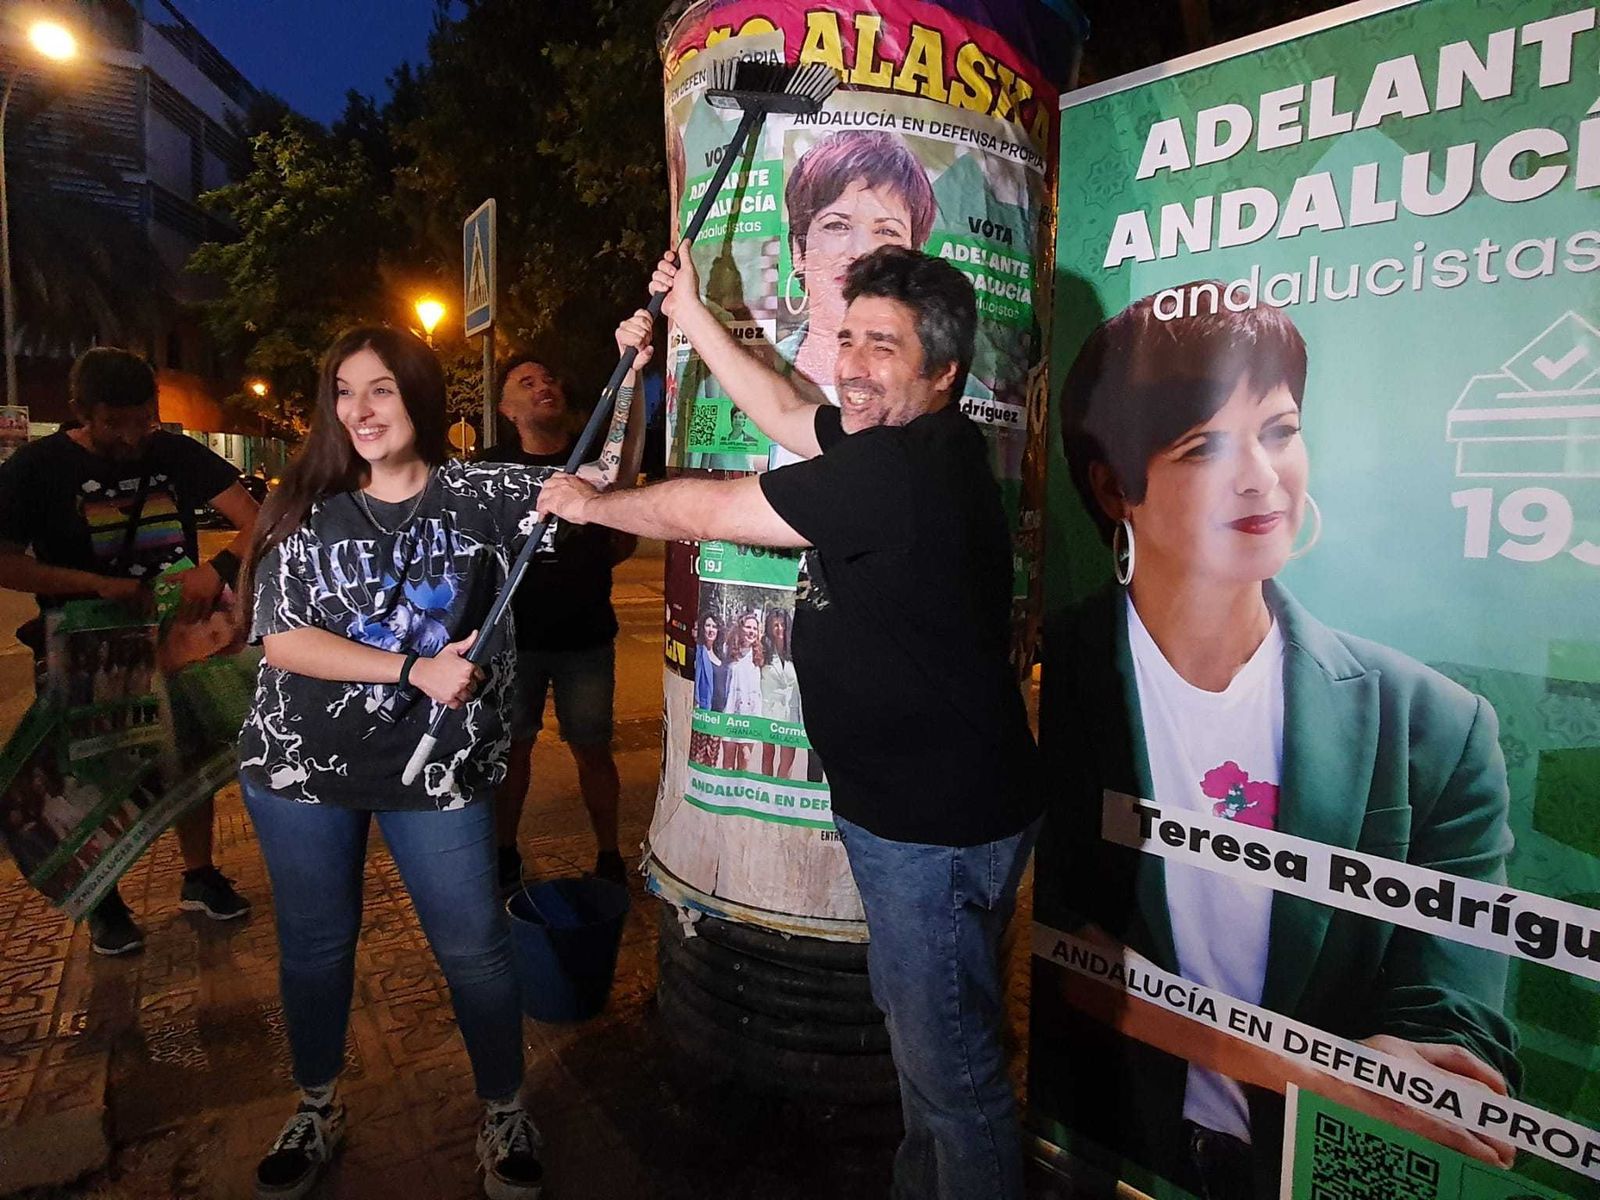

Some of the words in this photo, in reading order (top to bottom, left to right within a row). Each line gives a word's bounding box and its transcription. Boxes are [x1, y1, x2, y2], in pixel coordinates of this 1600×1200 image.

[1135, 6, 1600, 181] ADELANT
[705, 143, 744, 168] VOT
[793, 109, 897, 130] ANDALUCÍA
[901, 115, 926, 133] EN
[929, 119, 998, 151] DEFENSA
[999, 140, 1044, 169] PROPIA
[689, 168, 770, 202] ADANTE
[1103, 92, 1600, 269] ANDALUCÍ
[685, 190, 777, 228] AALUCÍA
[696, 220, 762, 242] ndalucistas
[968, 216, 1014, 246] VOTA
[939, 241, 1031, 280] ADELANTE
[1153, 230, 1600, 322] andalucistas
[961, 398, 1019, 423] dríguez
[703, 559, 723, 573] 19J
[726, 716, 751, 729] Ana
[770, 722, 807, 737] Carme
[691, 777, 770, 804] ANDALUCÍA
[774, 793, 796, 808] EN
[799, 797, 830, 811] DEF
[820, 830, 843, 842] ENTR
[1132, 803, 1308, 883] Teresa
[1329, 853, 1600, 963] Rodrígu
[1051, 939, 1219, 1024] ANDALUCÍA
[1228, 1008, 1272, 1043] EN
[1283, 1029, 1464, 1118] DEFENSA
[1477, 1101, 1600, 1181] PROP
